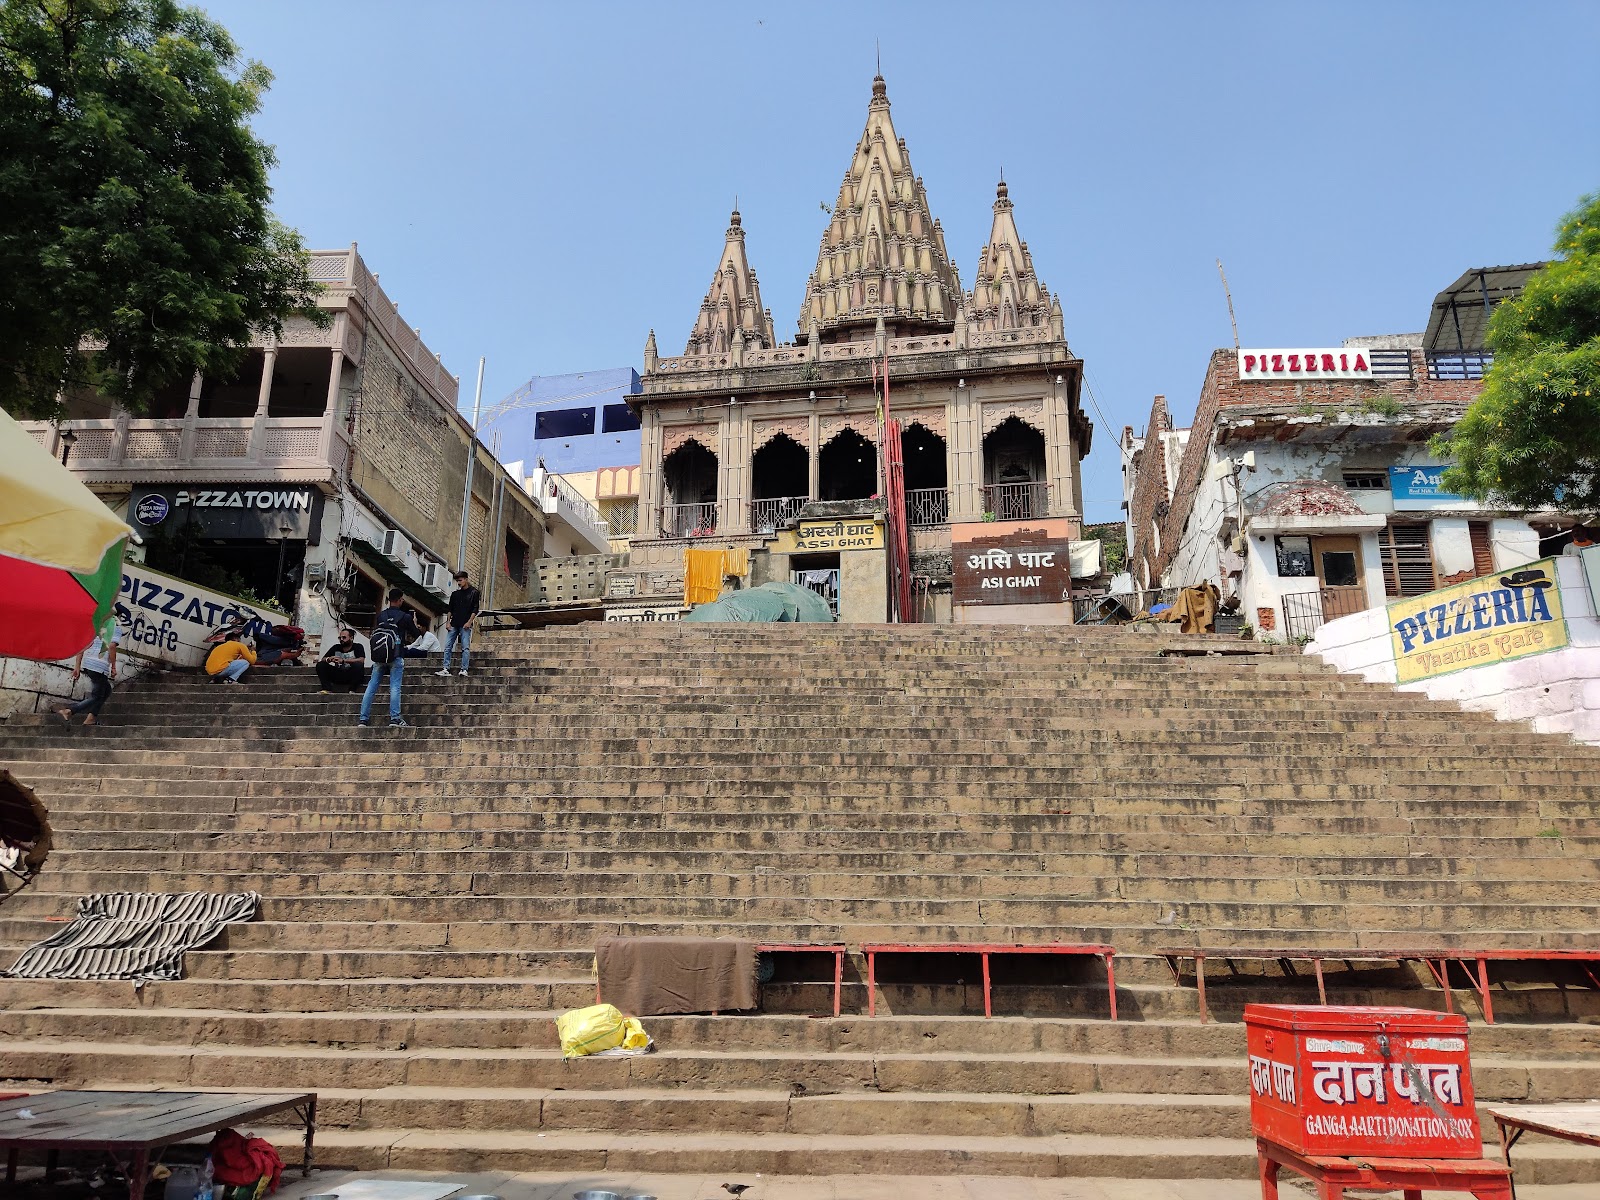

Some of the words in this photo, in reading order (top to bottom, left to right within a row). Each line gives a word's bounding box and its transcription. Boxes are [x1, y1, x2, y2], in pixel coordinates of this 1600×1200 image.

[1244, 354, 1368, 372] PIZZERIA
[1411, 470, 1443, 487] Am
[797, 522, 845, 538] अस्सी
[846, 525, 874, 535] घाट
[795, 540, 834, 548] ASSI
[838, 538, 874, 547] GHAT
[966, 549, 1012, 570] असि
[1017, 552, 1055, 568] घाट
[981, 577, 1003, 589] ASI
[1005, 576, 1042, 588] GHAT
[1394, 586, 1553, 653] PIZZERIA
[1416, 641, 1490, 673] Vaatika
[1250, 1054, 1273, 1098] दान
[1312, 1061, 1387, 1105] दान
[1450, 1118, 1475, 1139] BOX
